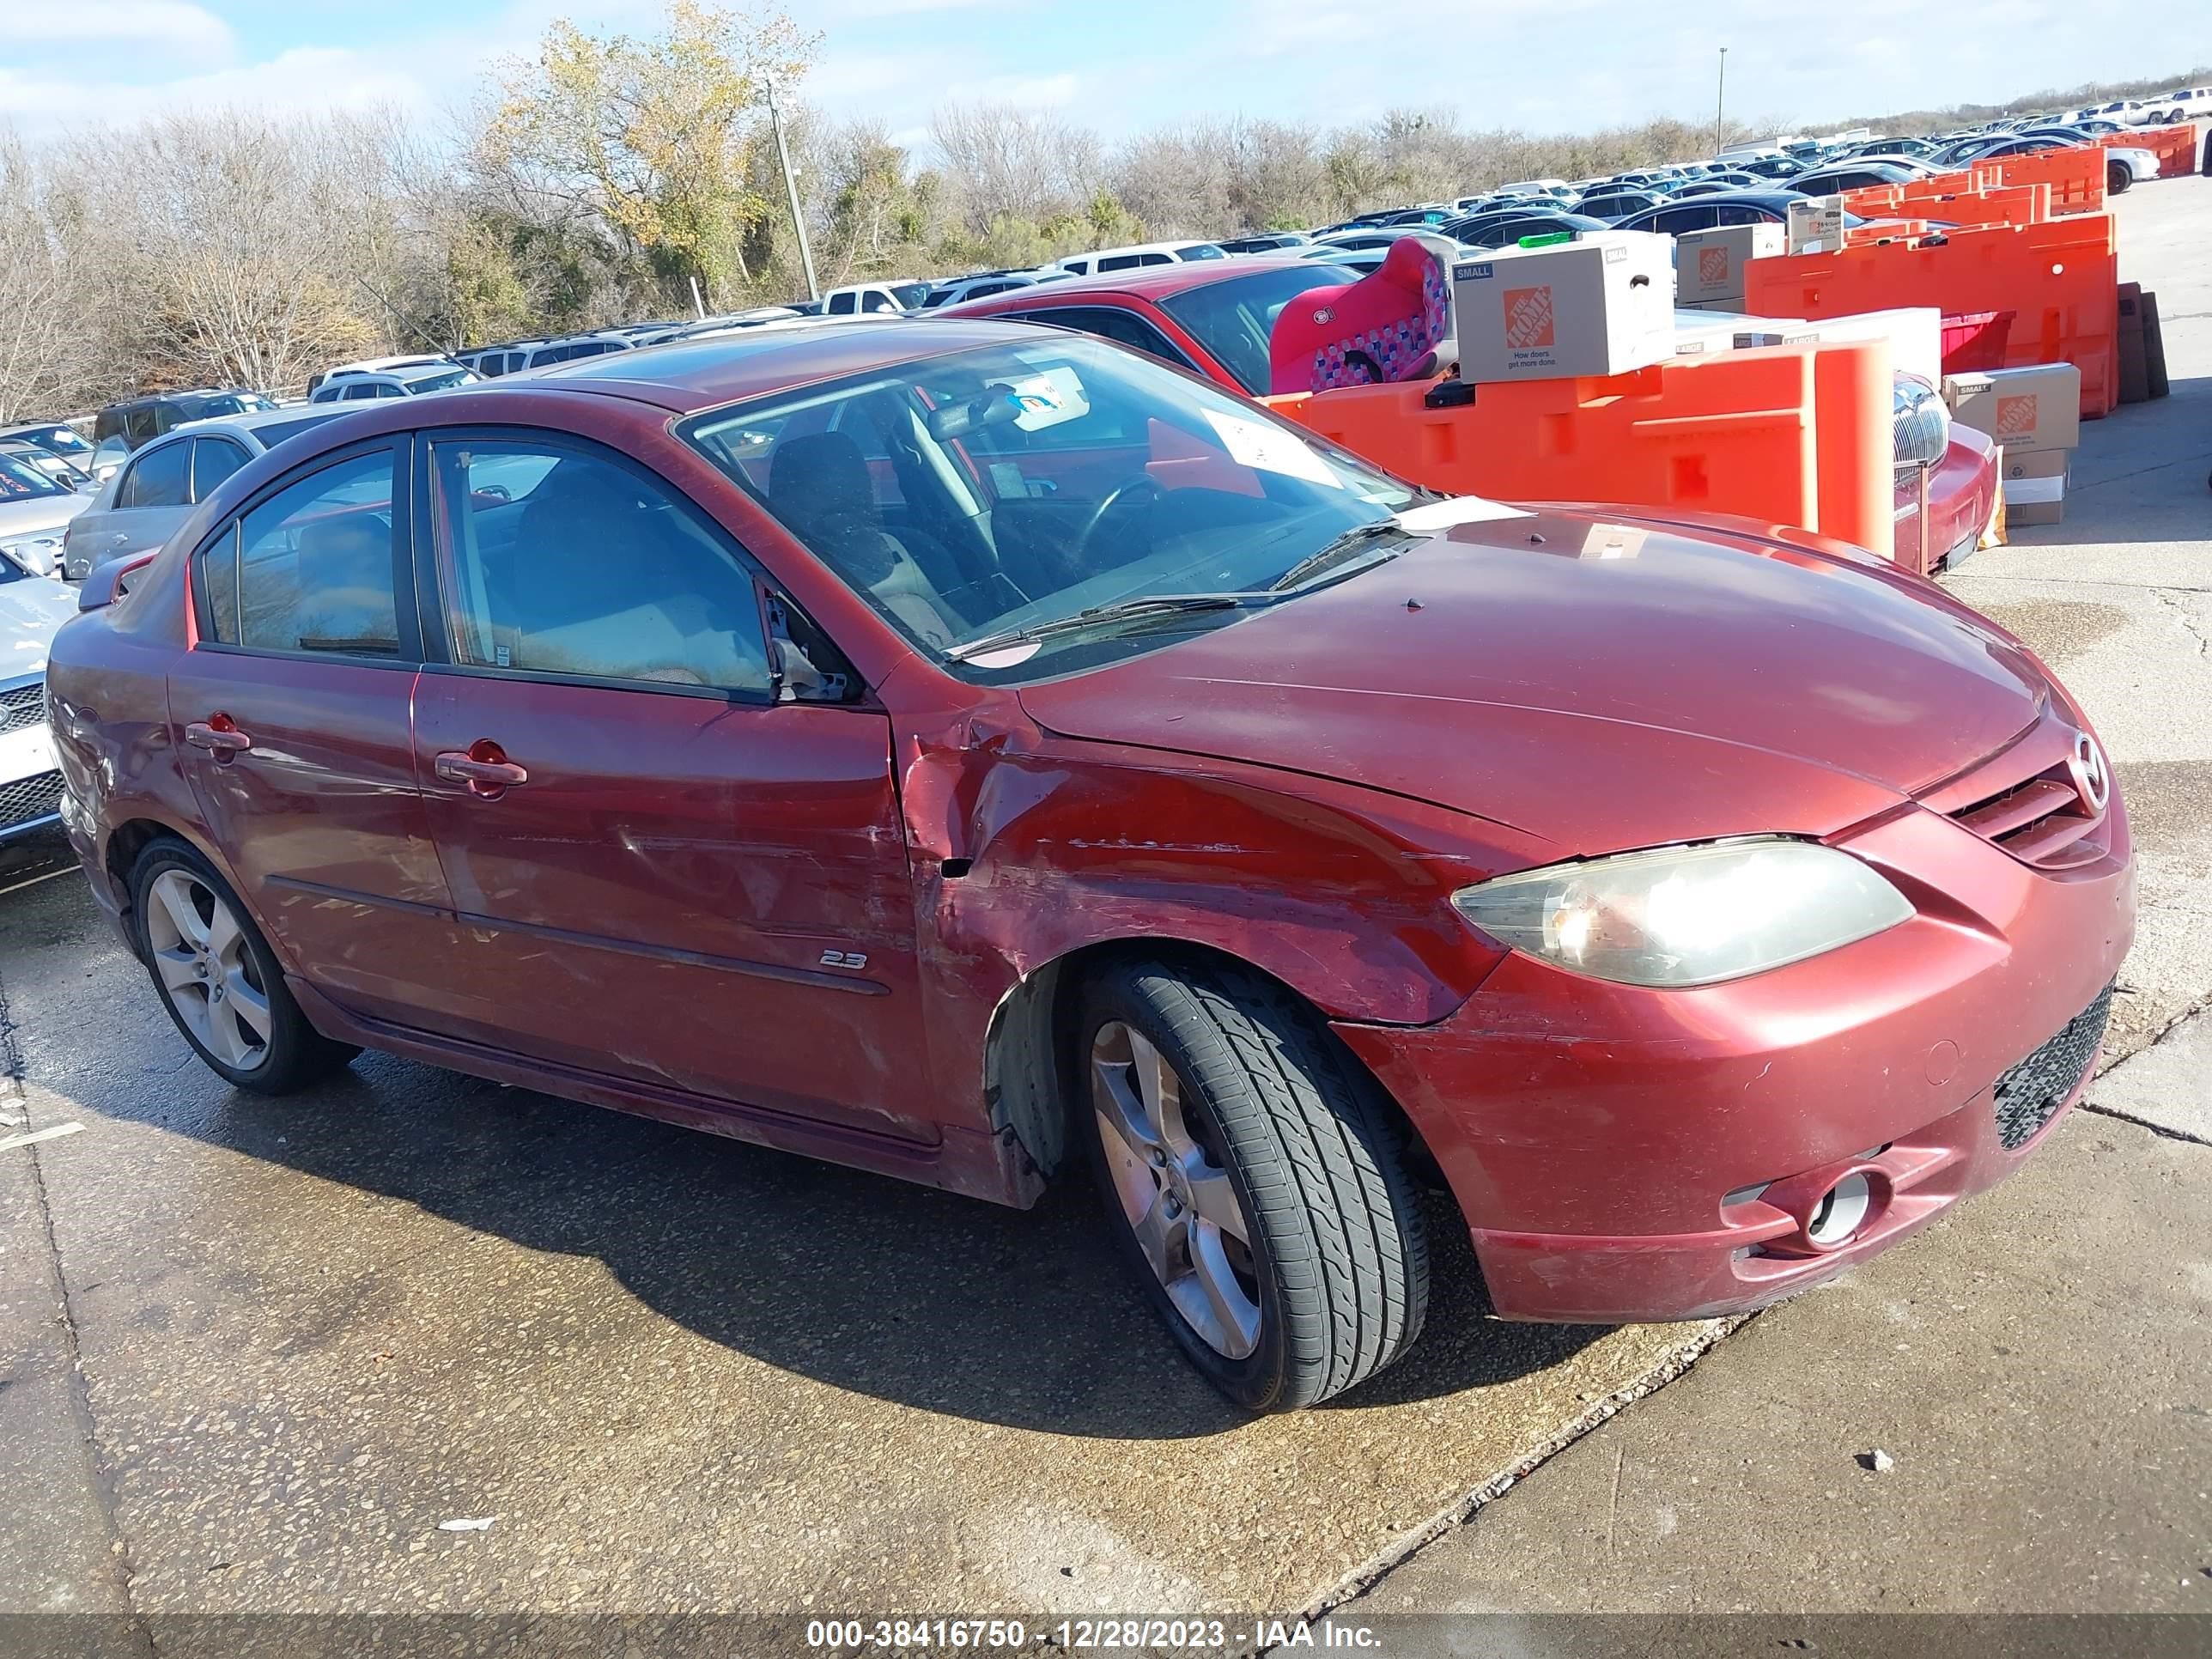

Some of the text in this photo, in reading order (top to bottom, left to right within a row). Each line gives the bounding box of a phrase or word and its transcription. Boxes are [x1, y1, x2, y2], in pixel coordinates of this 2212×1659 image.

[1457, 266, 1490, 278] SMALL
[1507, 286, 1551, 347] HOME
[1960, 384, 1989, 394] SMALL
